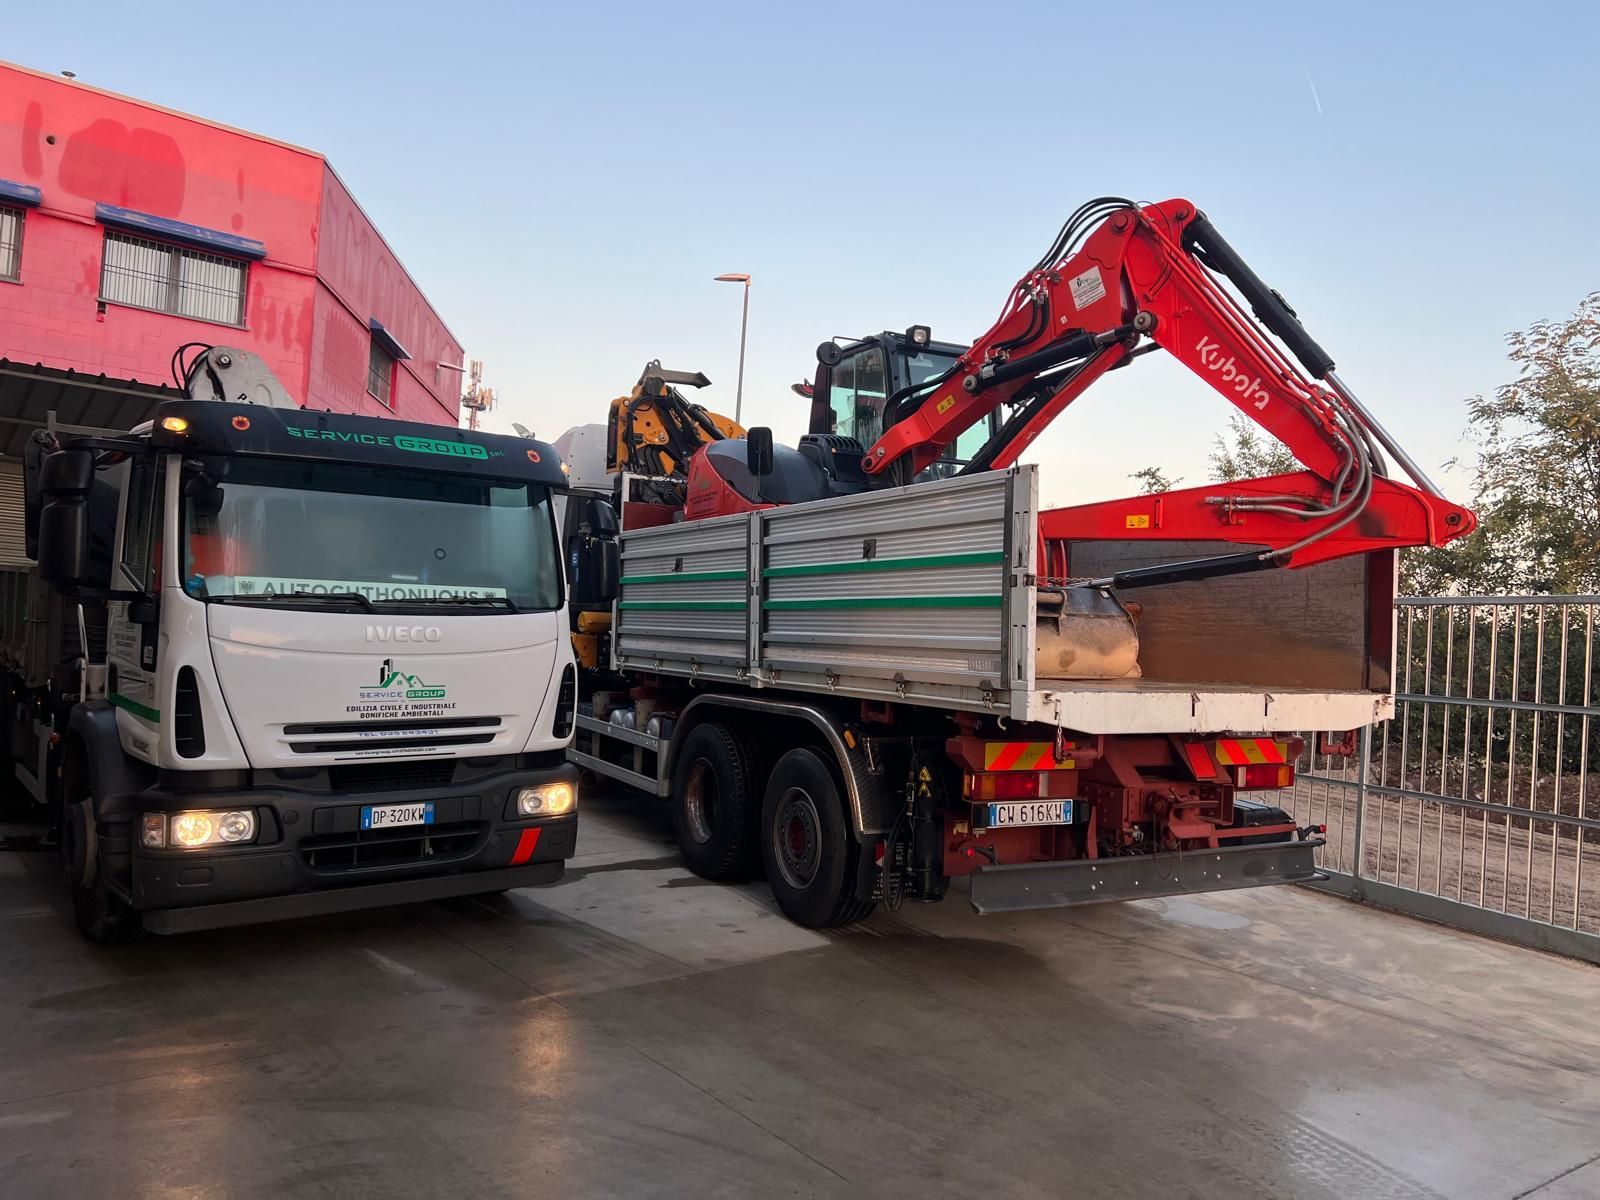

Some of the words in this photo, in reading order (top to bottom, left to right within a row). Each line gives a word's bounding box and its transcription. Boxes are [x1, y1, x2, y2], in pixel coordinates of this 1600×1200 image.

[1195, 335, 1270, 410] Kubota
[287, 426, 392, 447] SERVICE
[399, 439, 484, 456] GROUP
[365, 625, 442, 643] IVECO
[360, 691, 403, 699] SERVICE
[373, 810, 386, 824] DP
[999, 806, 1015, 823] CW
[1020, 804, 1062, 822] 616KW
